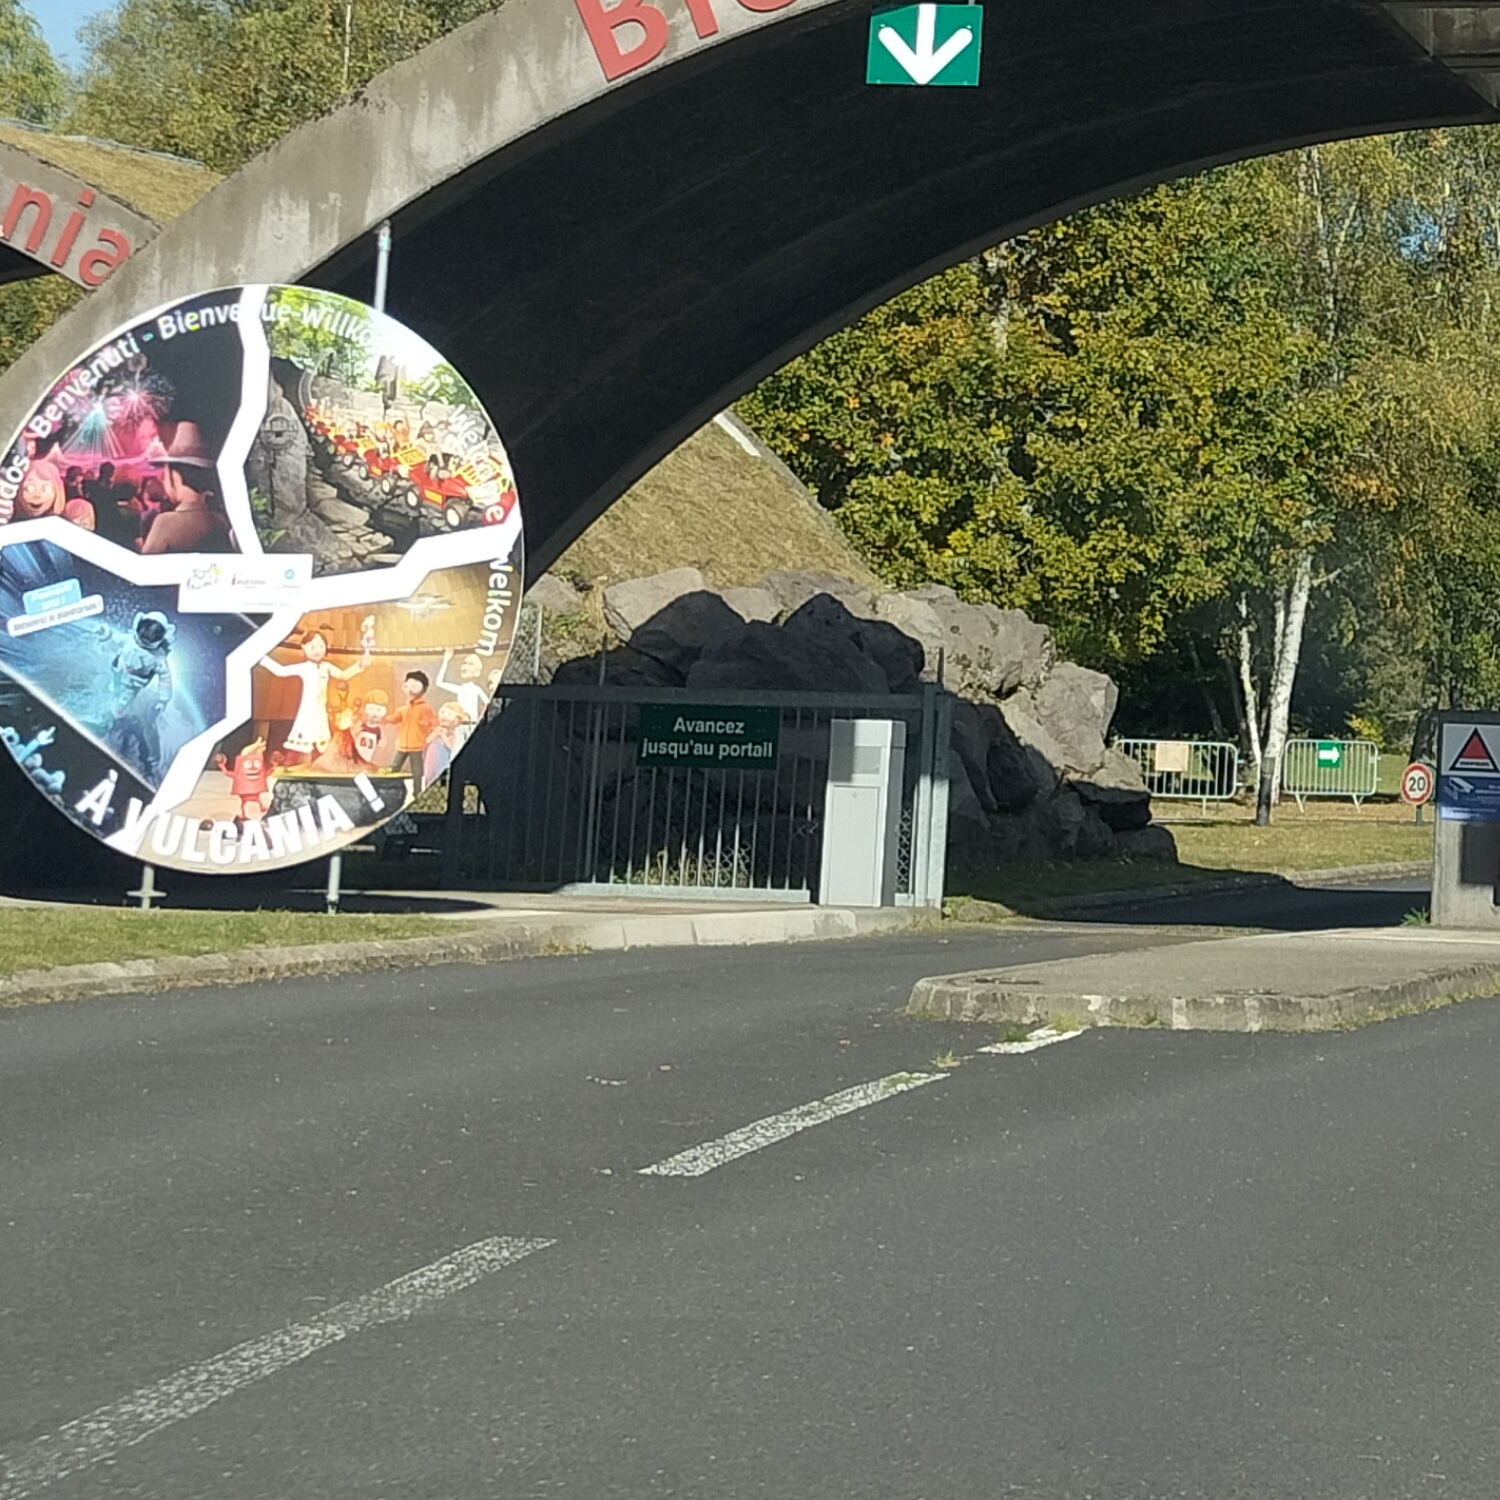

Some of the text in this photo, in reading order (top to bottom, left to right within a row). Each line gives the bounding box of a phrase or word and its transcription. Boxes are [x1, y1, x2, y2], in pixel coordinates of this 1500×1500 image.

[29, 331, 141, 438] Benvenuti
[157, 303, 291, 340] Bienveue
[673, 716, 745, 734] Avancez
[641, 738, 773, 760] jusqu'au portail
[1408, 776, 1427, 793] 20
[124, 794, 356, 864] VULCANIA
